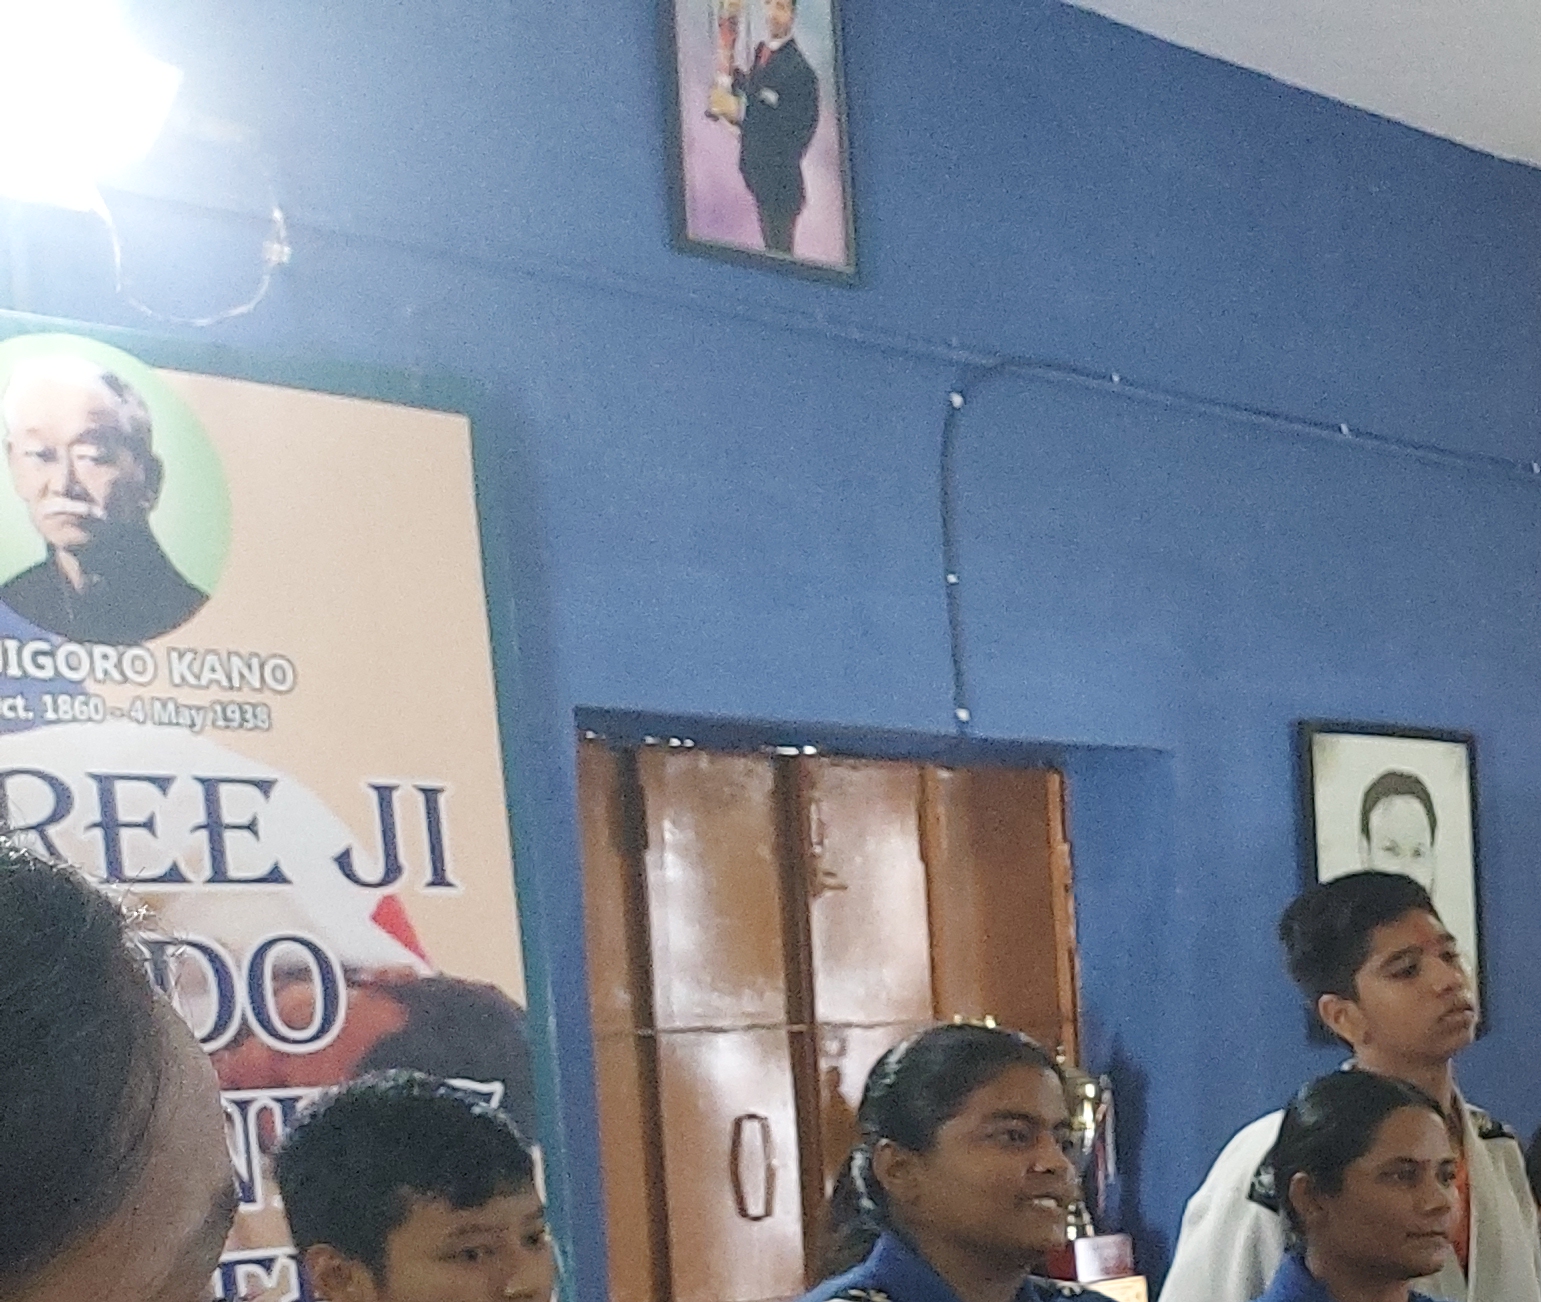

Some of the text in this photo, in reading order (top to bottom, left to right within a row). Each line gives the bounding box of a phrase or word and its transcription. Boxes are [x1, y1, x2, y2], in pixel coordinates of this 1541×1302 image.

[0, 637, 296, 693] IGORO KANO
[0, 694, 35, 721] ct.
[42, 693, 104, 722] 1860
[128, 695, 147, 724] 4
[151, 696, 206, 733] May
[0, 768, 457, 889] REE JI
[134, 934, 343, 1045] DO
